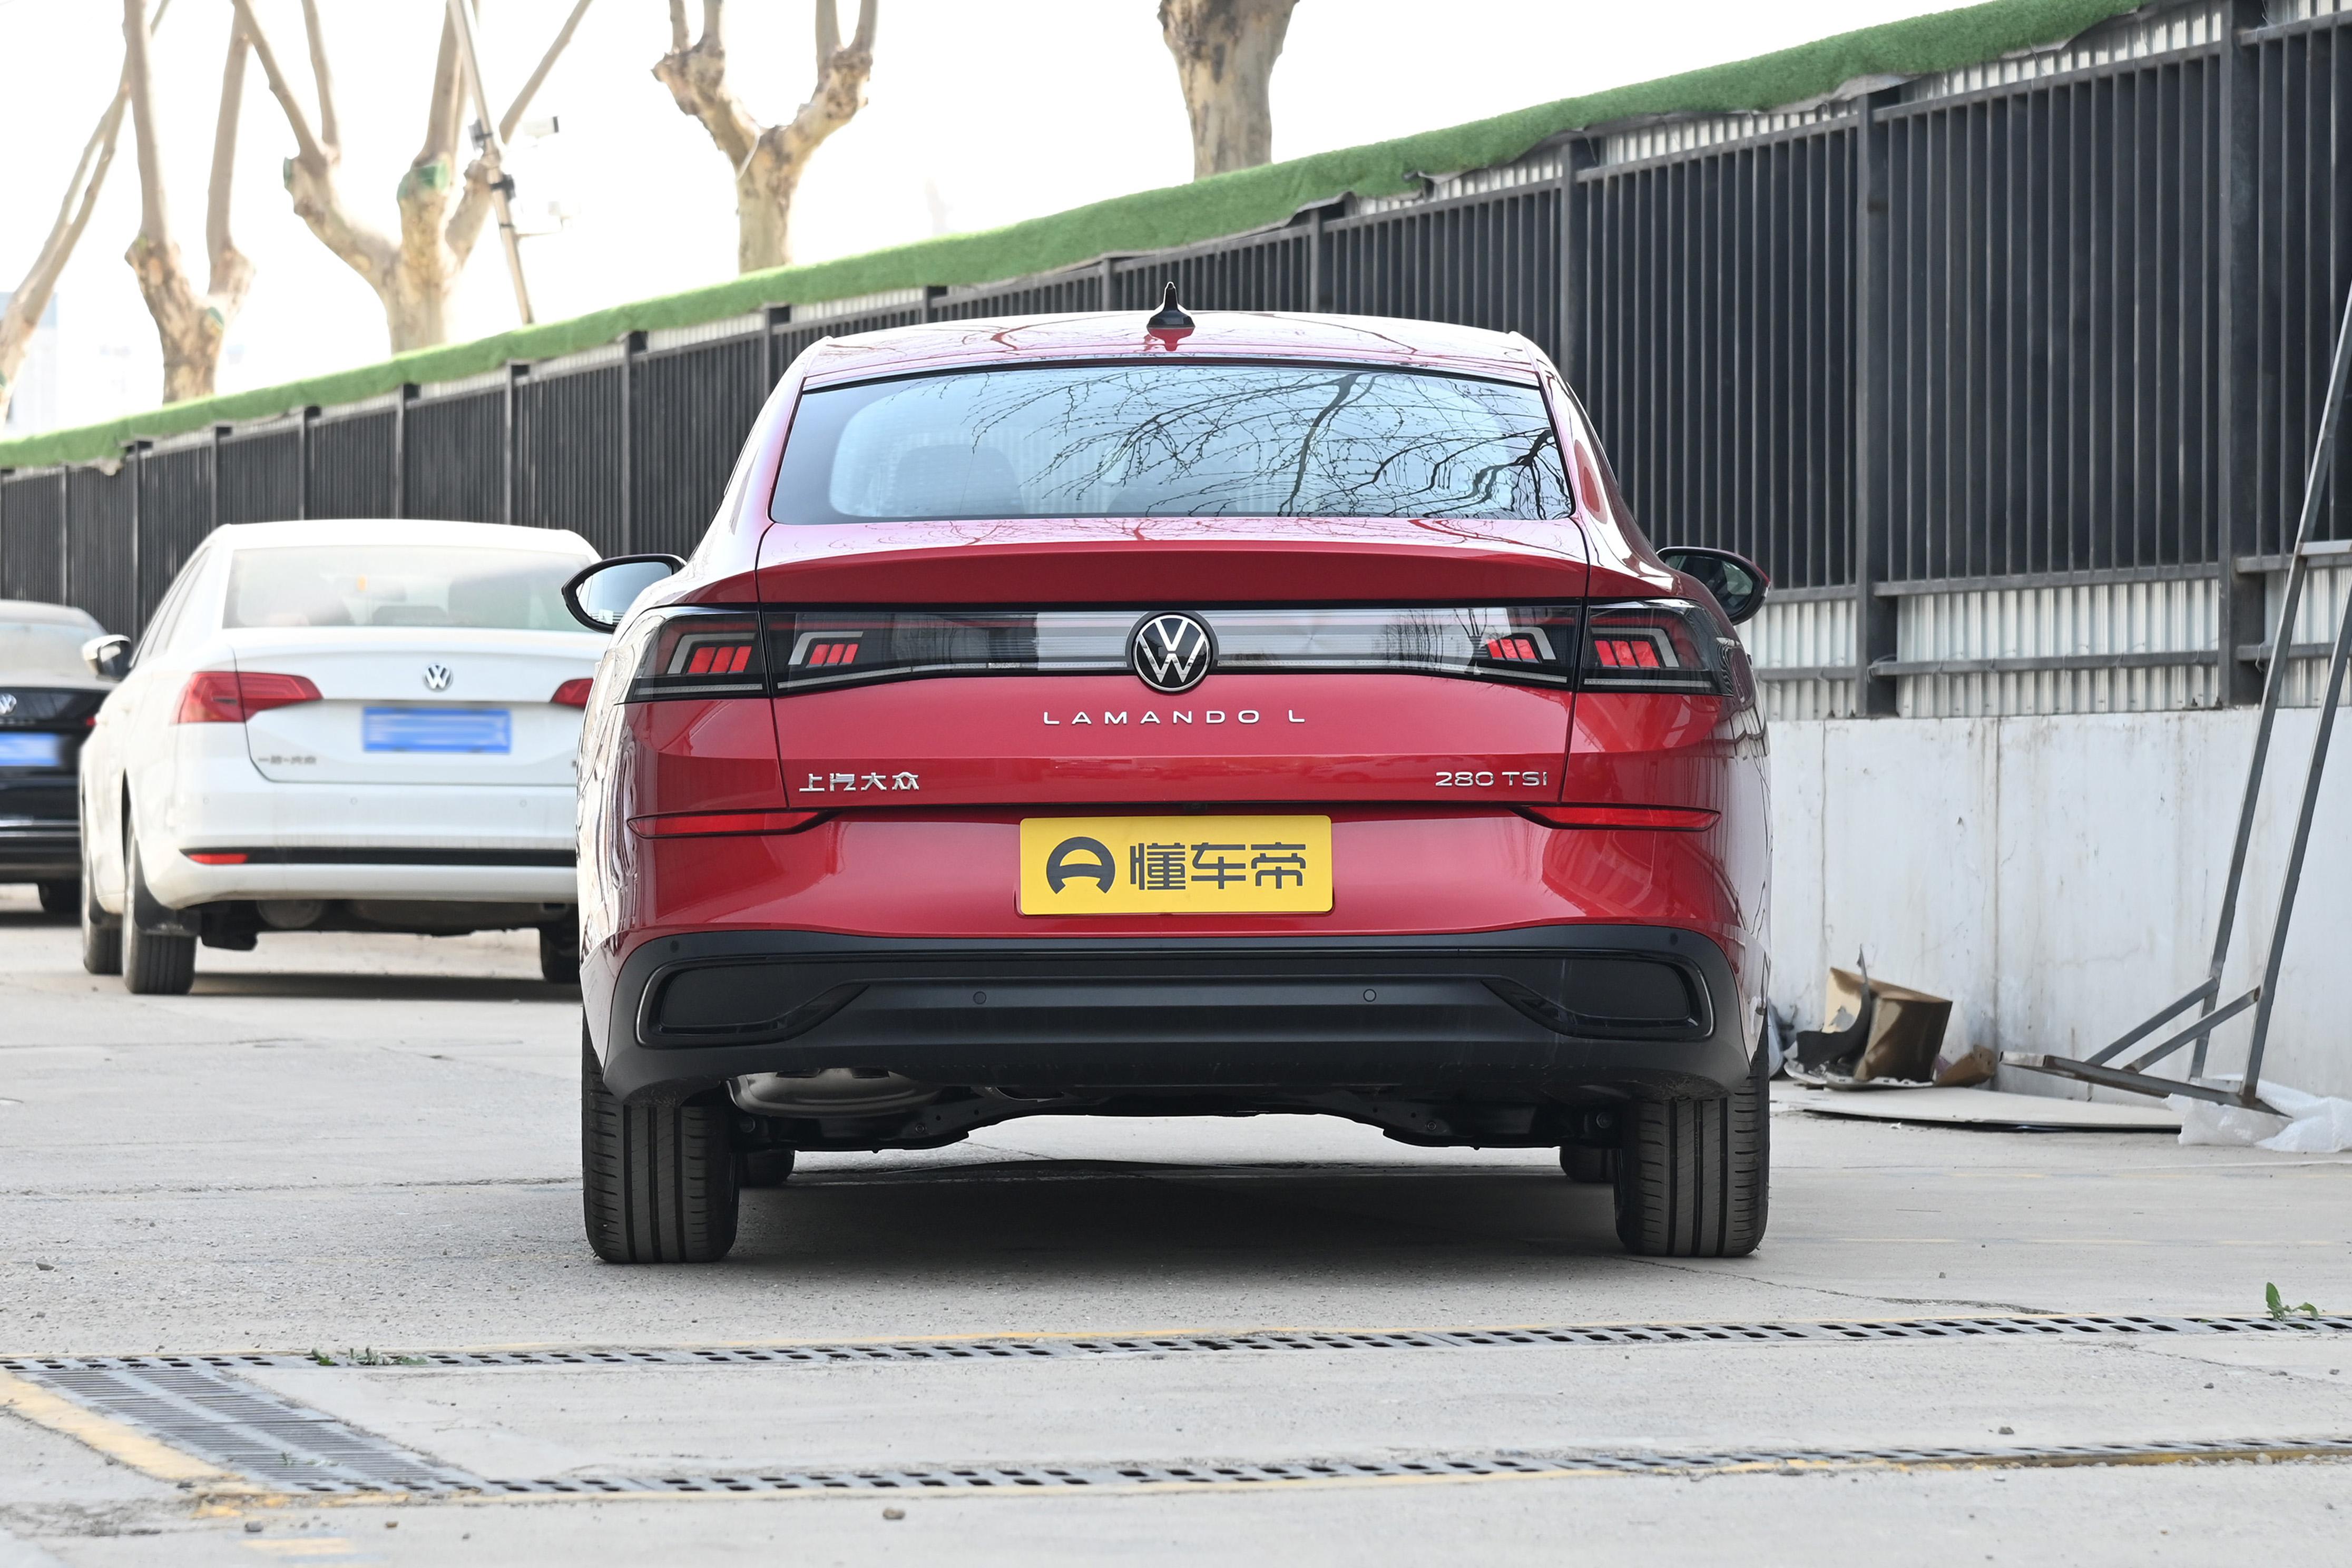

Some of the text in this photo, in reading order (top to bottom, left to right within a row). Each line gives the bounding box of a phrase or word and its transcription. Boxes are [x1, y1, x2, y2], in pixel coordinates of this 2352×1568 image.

[1136, 616, 1209, 689] VW
[424, 663, 452, 691] VW
[1043, 710, 1305, 724] LAMANDO L
[799, 771, 919, 792] 上汽大众
[1435, 771, 1547, 786] 280 TSI
[1130, 842, 1306, 890] 懂车帝
